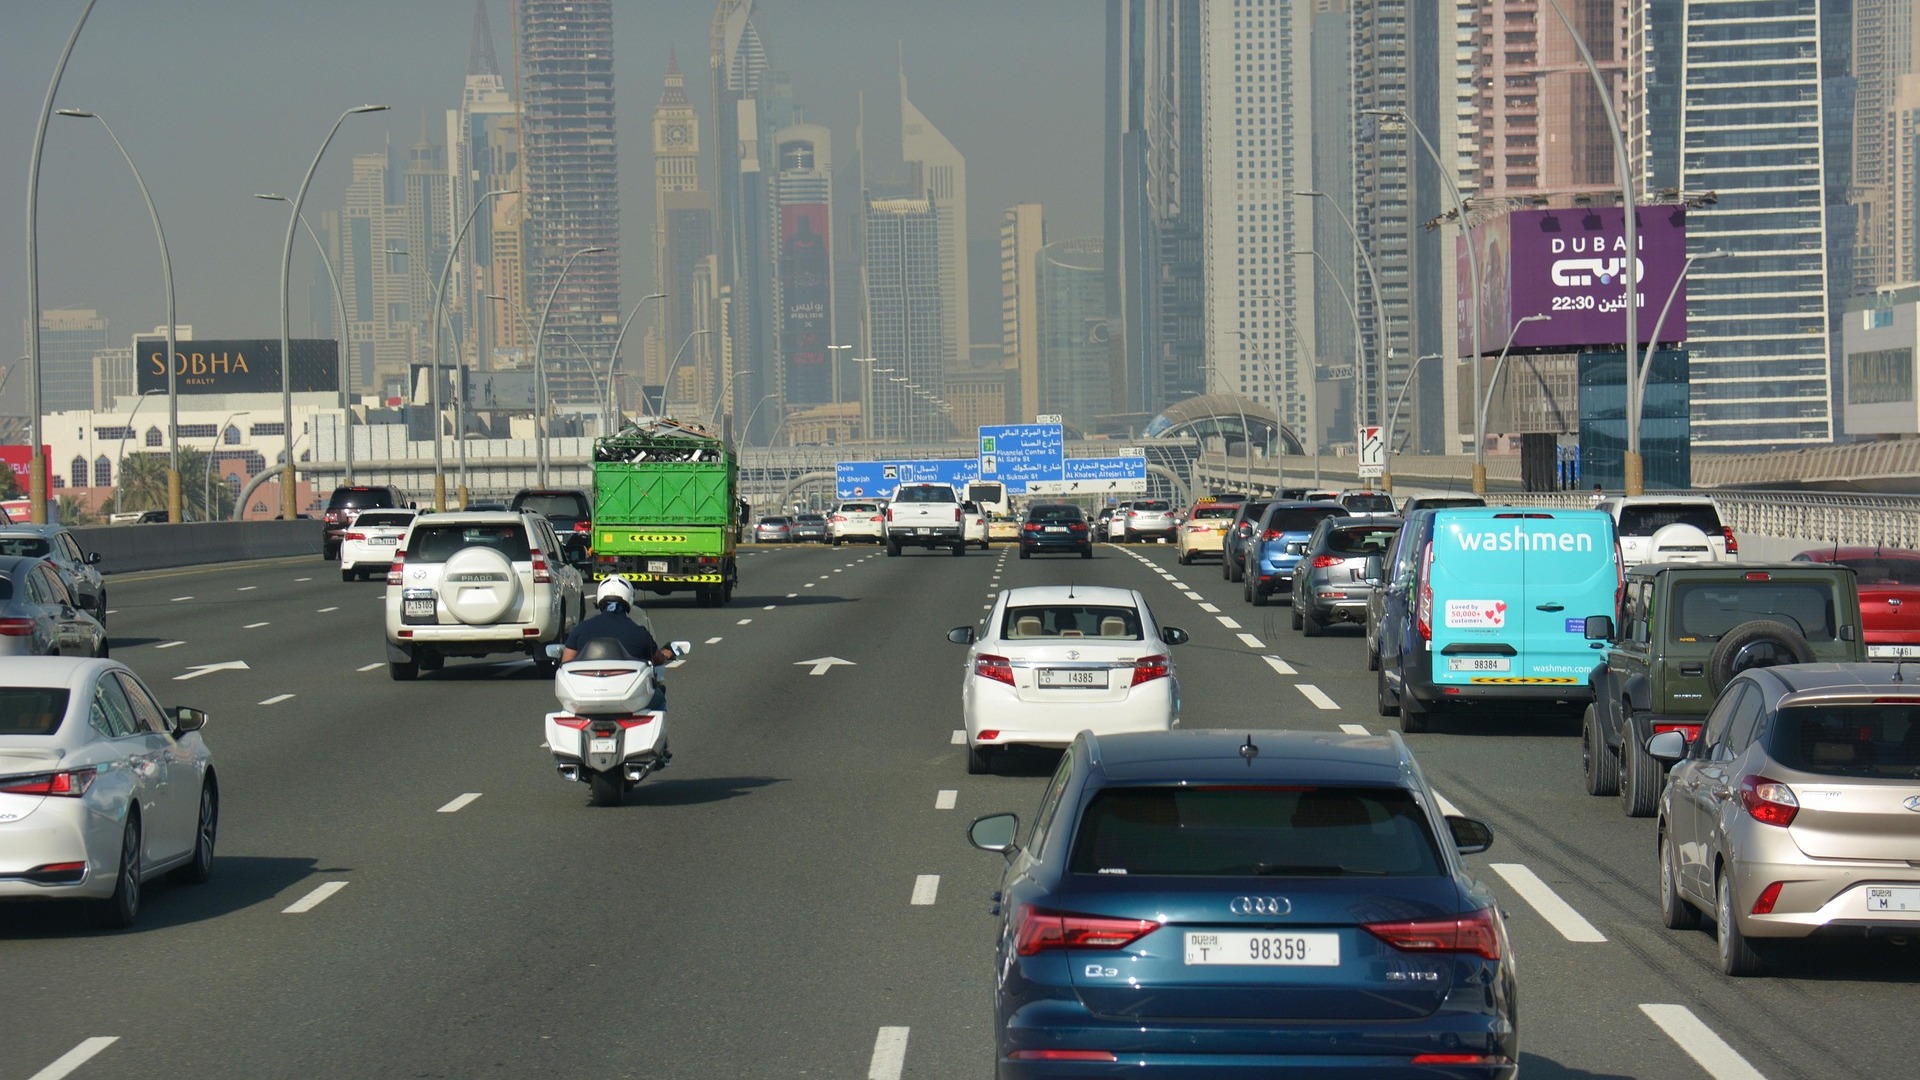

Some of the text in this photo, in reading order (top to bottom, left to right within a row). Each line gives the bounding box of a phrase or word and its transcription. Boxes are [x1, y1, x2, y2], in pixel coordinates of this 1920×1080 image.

[1552, 235, 1643, 253] DUBAI
[791, 301, 824, 313] بوليس
[1552, 295, 1595, 311] 22:30
[151, 351, 249, 375] SOBHA
[1049, 415, 1060, 423] 50
[1042, 428, 1060, 437] شارع
[1042, 439, 1061, 448] شارع
[913, 473, 937, 481] (North)
[1457, 525, 1592, 552] washmen
[1474, 660, 1498, 669] 98384
[1533, 664, 1592, 673] washmen.com
[1068, 672, 1093, 683] 14385
[1880, 898, 1888, 909] M
[1200, 938, 1306, 961] T 98359
[1085, 964, 1118, 977] Q3
